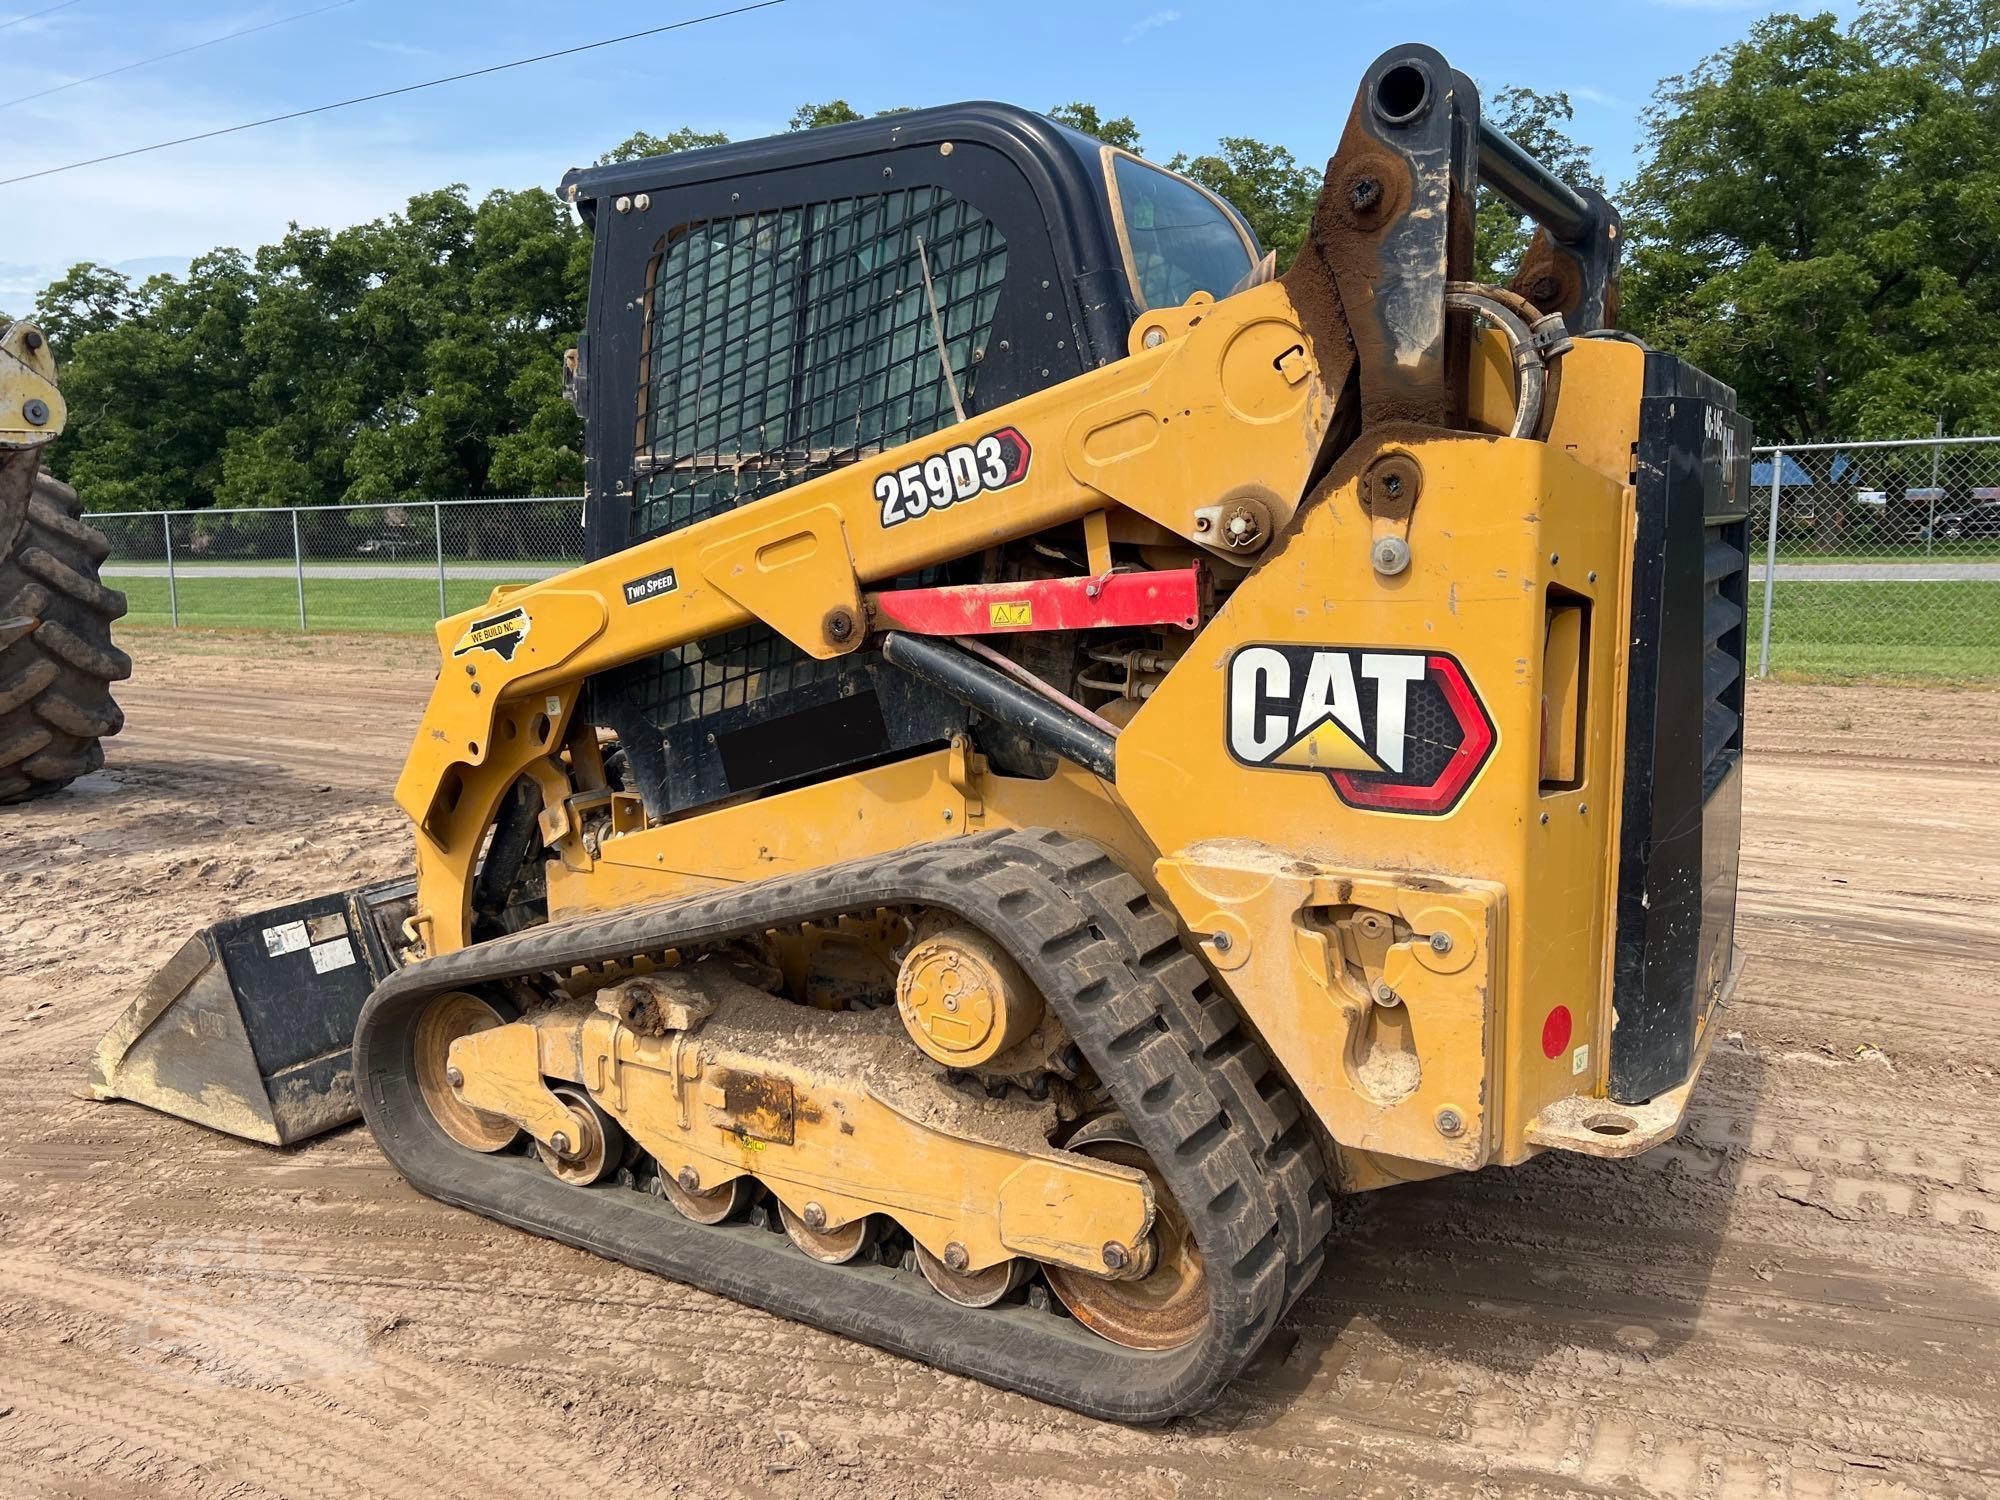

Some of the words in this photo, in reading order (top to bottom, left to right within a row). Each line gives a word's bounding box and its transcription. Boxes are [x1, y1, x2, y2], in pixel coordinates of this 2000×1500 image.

[875, 436, 1008, 526] 259D3
[471, 633, 483, 643] WE
[484, 625, 503, 640] BUILD
[504, 621, 514, 633] NC
[1231, 647, 1426, 773] CAT
